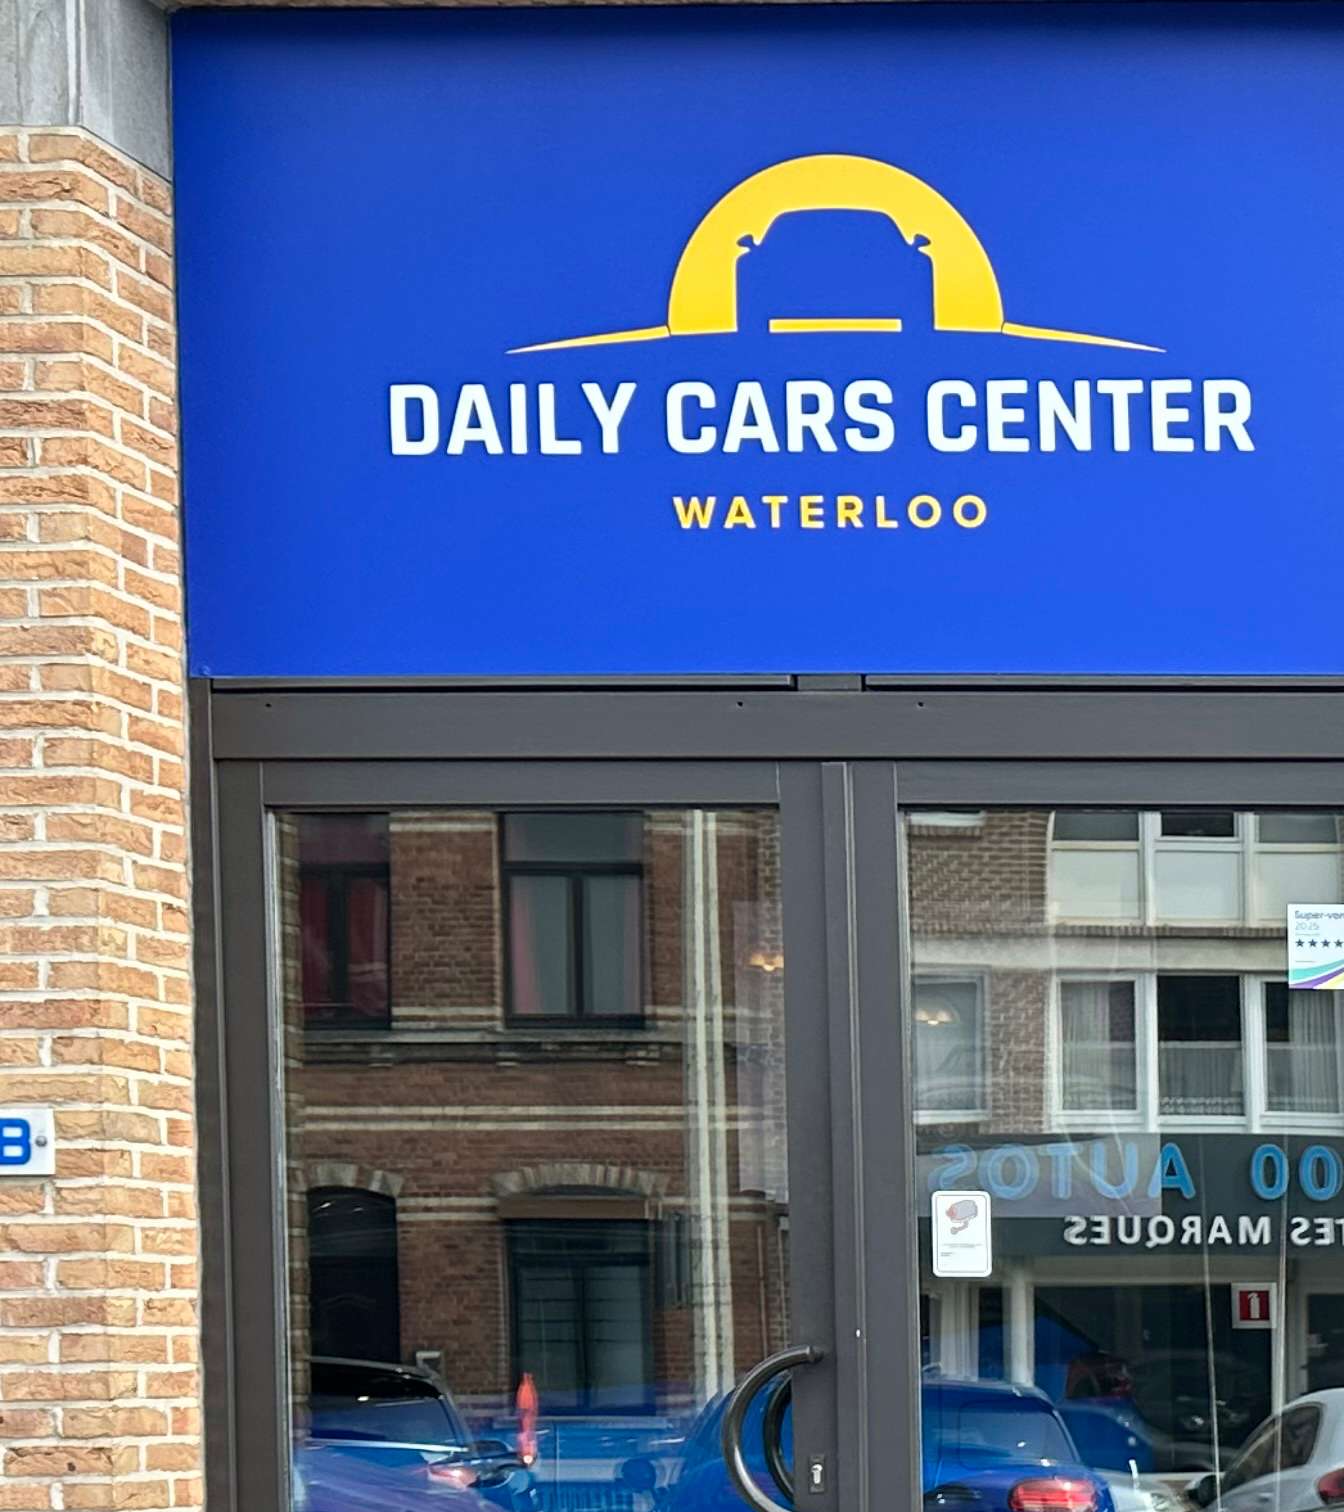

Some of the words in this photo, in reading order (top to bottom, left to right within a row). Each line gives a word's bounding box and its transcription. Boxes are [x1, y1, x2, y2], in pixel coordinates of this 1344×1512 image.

[389, 382, 637, 457] DAILY
[666, 379, 895, 456] CARS
[927, 379, 1256, 454] CENTER
[672, 494, 990, 531] WATERLOO
